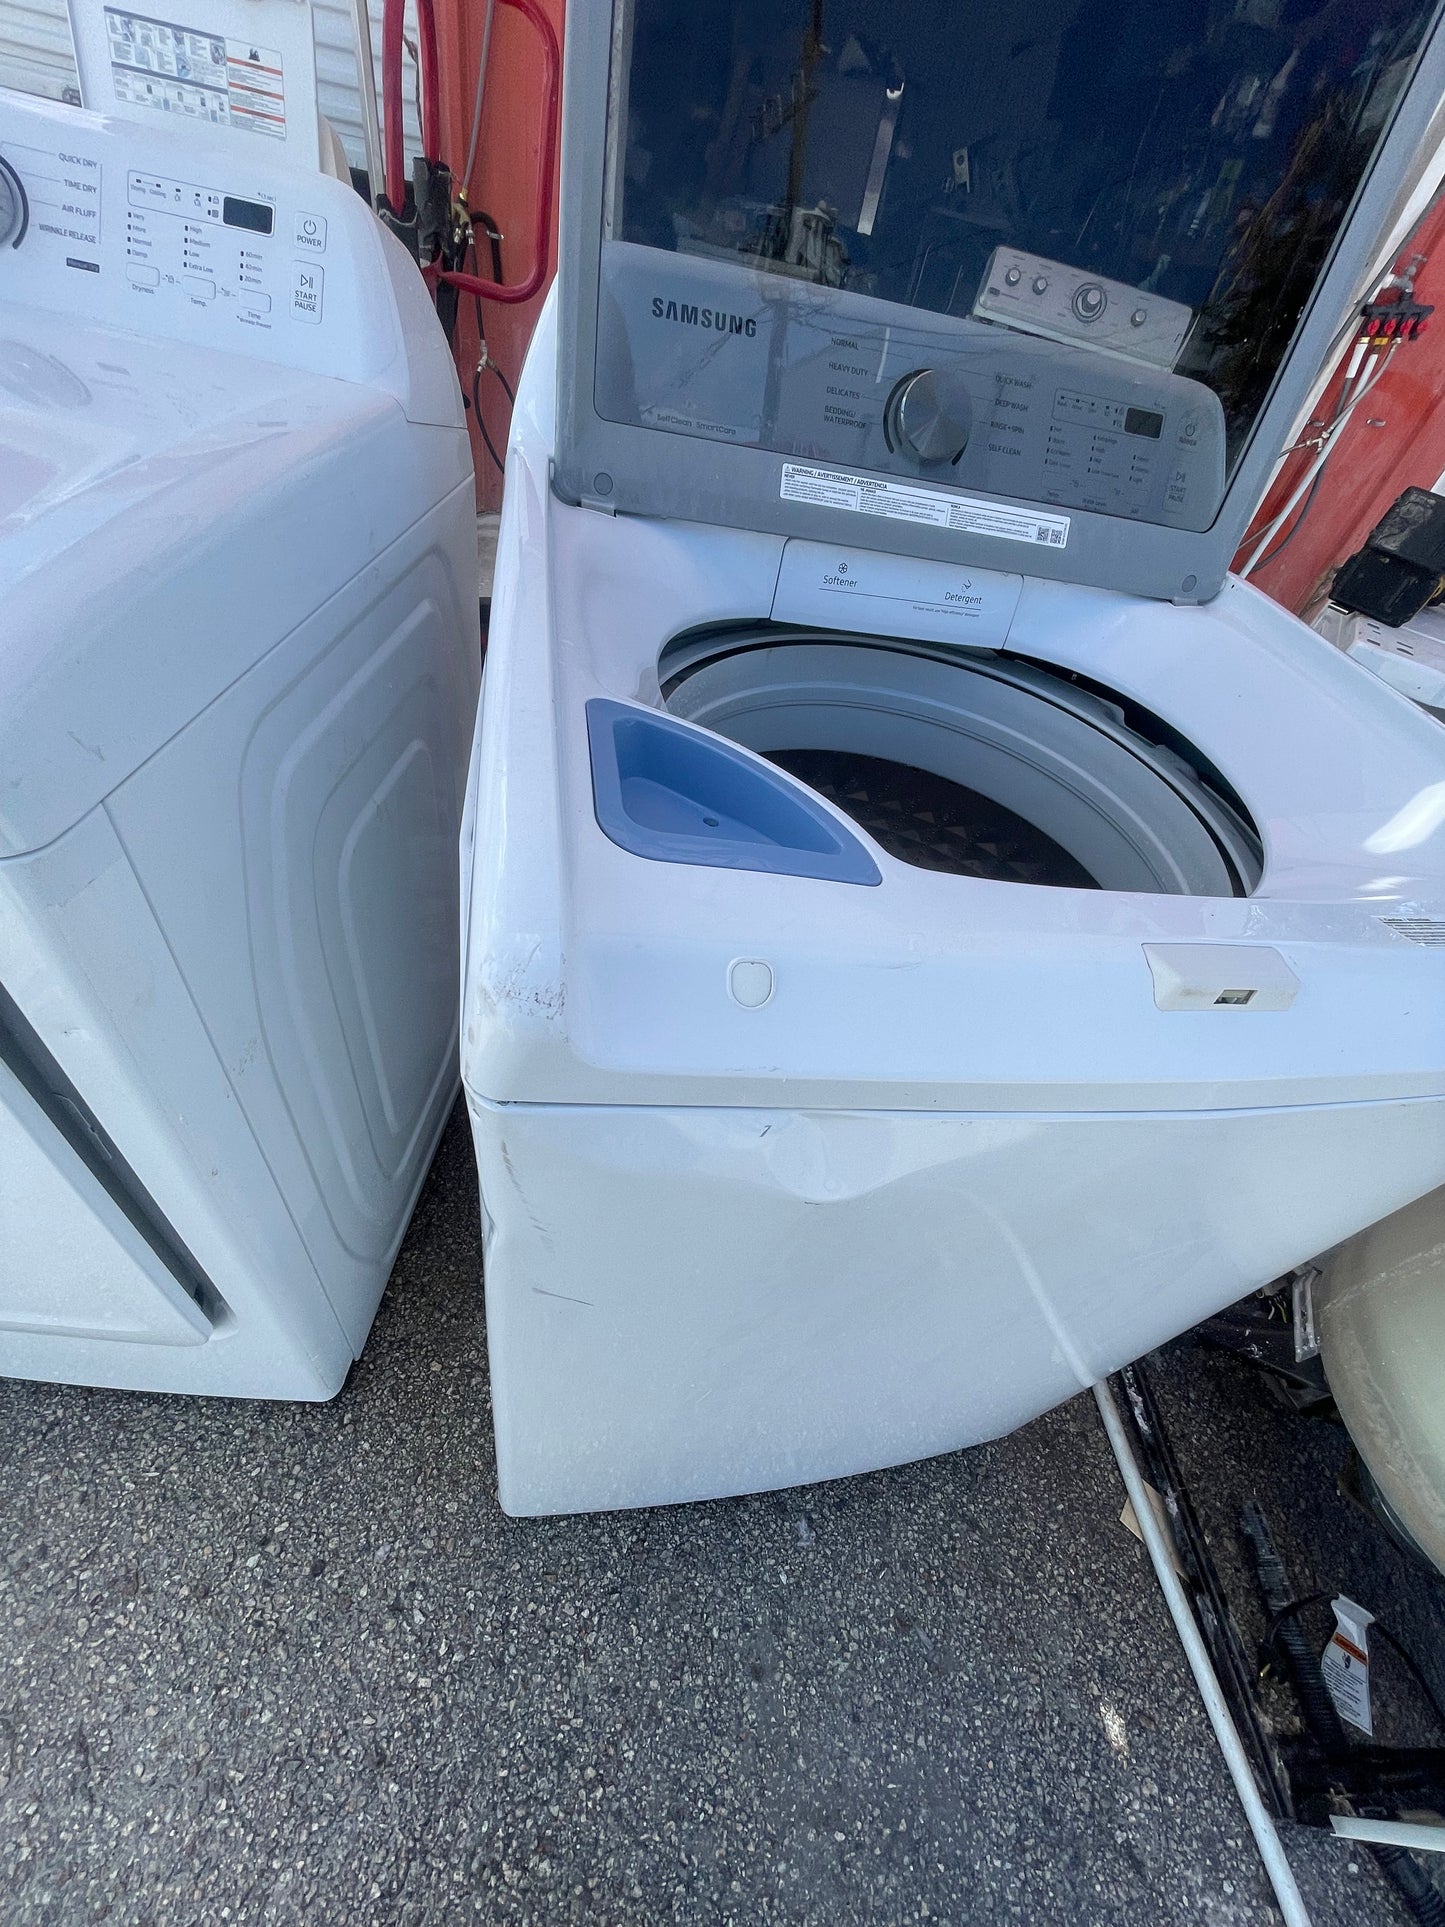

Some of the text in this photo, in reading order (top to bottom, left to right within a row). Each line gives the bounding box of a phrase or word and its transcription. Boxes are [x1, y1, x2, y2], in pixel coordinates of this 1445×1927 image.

[58, 152, 98, 170] QUICK DRY
[64, 179, 97, 194] TIME DRY
[62, 204, 96, 218] AIR FLUFF
[39, 224, 96, 244] WRINKLE RELEASE
[296, 234, 322, 248] POWER
[188, 263, 213, 273] Extra Low
[132, 283, 154, 295] Dryness
[295, 290, 317, 301] START
[294, 301, 316, 313] PAUSE
[248, 311, 261, 320] Time
[652, 297, 757, 338] SAMSUNG
[831, 337, 859, 350] NORMAL
[829, 361, 868, 377] HEAVY DUTY
[995, 374, 1032, 390] QUICK WASH
[826, 386, 860, 400] DELICATES
[824, 405, 856, 418] BEDDING/
[995, 398, 1028, 412] DEEP WASH
[657, 414, 737, 436] SelfClean SmartCare
[824, 414, 867, 429] WATERPROOF
[988, 443, 1021, 456] SELF CLEAN
[791, 466, 814, 476] WARNING
[818, 471, 854, 483] AVERTISSEMENT
[857, 480, 888, 490] ADVERTENCIA
[823, 574, 858, 588] Softener
[944, 591, 982, 604] Detergent
